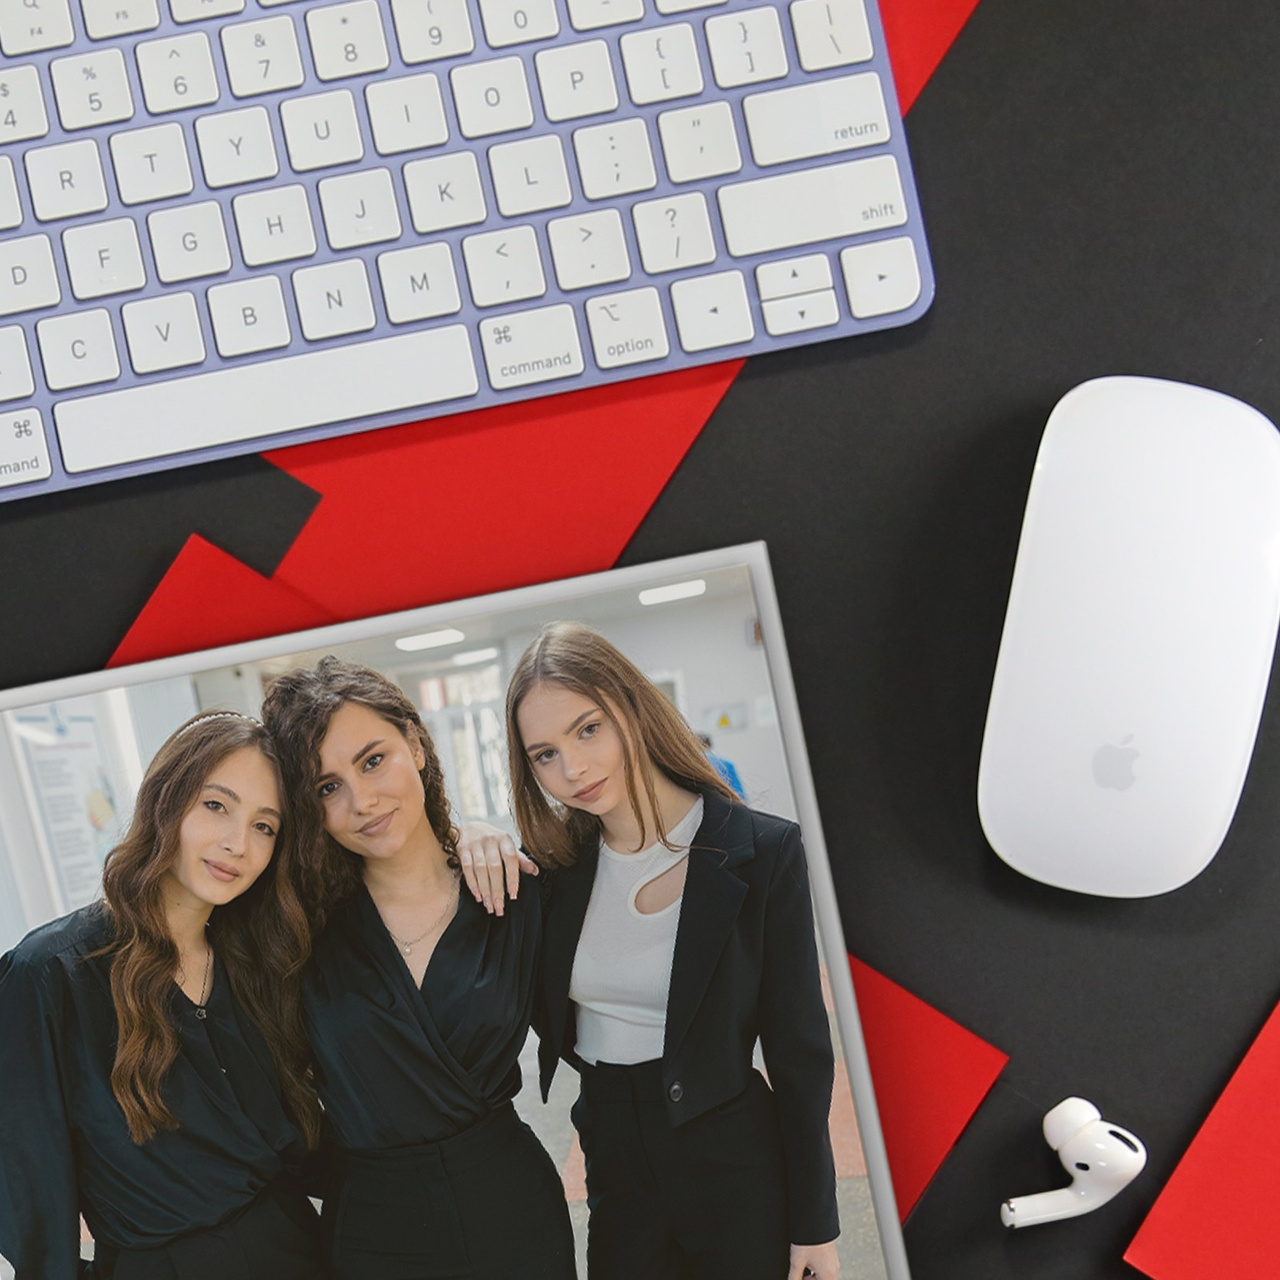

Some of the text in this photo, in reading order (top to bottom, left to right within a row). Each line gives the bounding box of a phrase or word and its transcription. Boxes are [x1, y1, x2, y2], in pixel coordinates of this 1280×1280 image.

[115, 9, 129, 21] F5
[29, 26, 44, 37] F4
[253, 33, 267, 48] &
[428, 25, 443, 46] 9
[738, 21, 749, 44] }
[343, 42, 359, 63] 8
[655, 37, 666, 60] {
[258, 58, 271, 79] 7
[745, 51, 755, 73] ]
[81, 66, 97, 81] %
[569, 70, 585, 91] P
[660, 67, 671, 90] [
[0, 82, 10, 98] $
[173, 75, 188, 96] 6
[88, 91, 103, 112] 5
[3, 109, 17, 128] 4
[313, 119, 331, 141] U
[833, 122, 880, 140] return
[228, 136, 243, 157] Y
[143, 152, 158, 173] T
[58, 169, 75, 191] R
[523, 166, 539, 186] L
[437, 182, 454, 203] K
[354, 198, 367, 219] J
[664, 207, 678, 228] ?
[861, 203, 896, 221] shift
[266, 214, 284, 236] H
[181, 231, 199, 252] G
[97, 248, 111, 269] F
[10, 265, 28, 286] D
[409, 272, 430, 294] M
[325, 289, 343, 310] N
[241, 306, 258, 327] B
[154, 322, 171, 343] V
[70, 339, 87, 360] C
[606, 337, 654, 358] option
[501, 353, 572, 378] command
